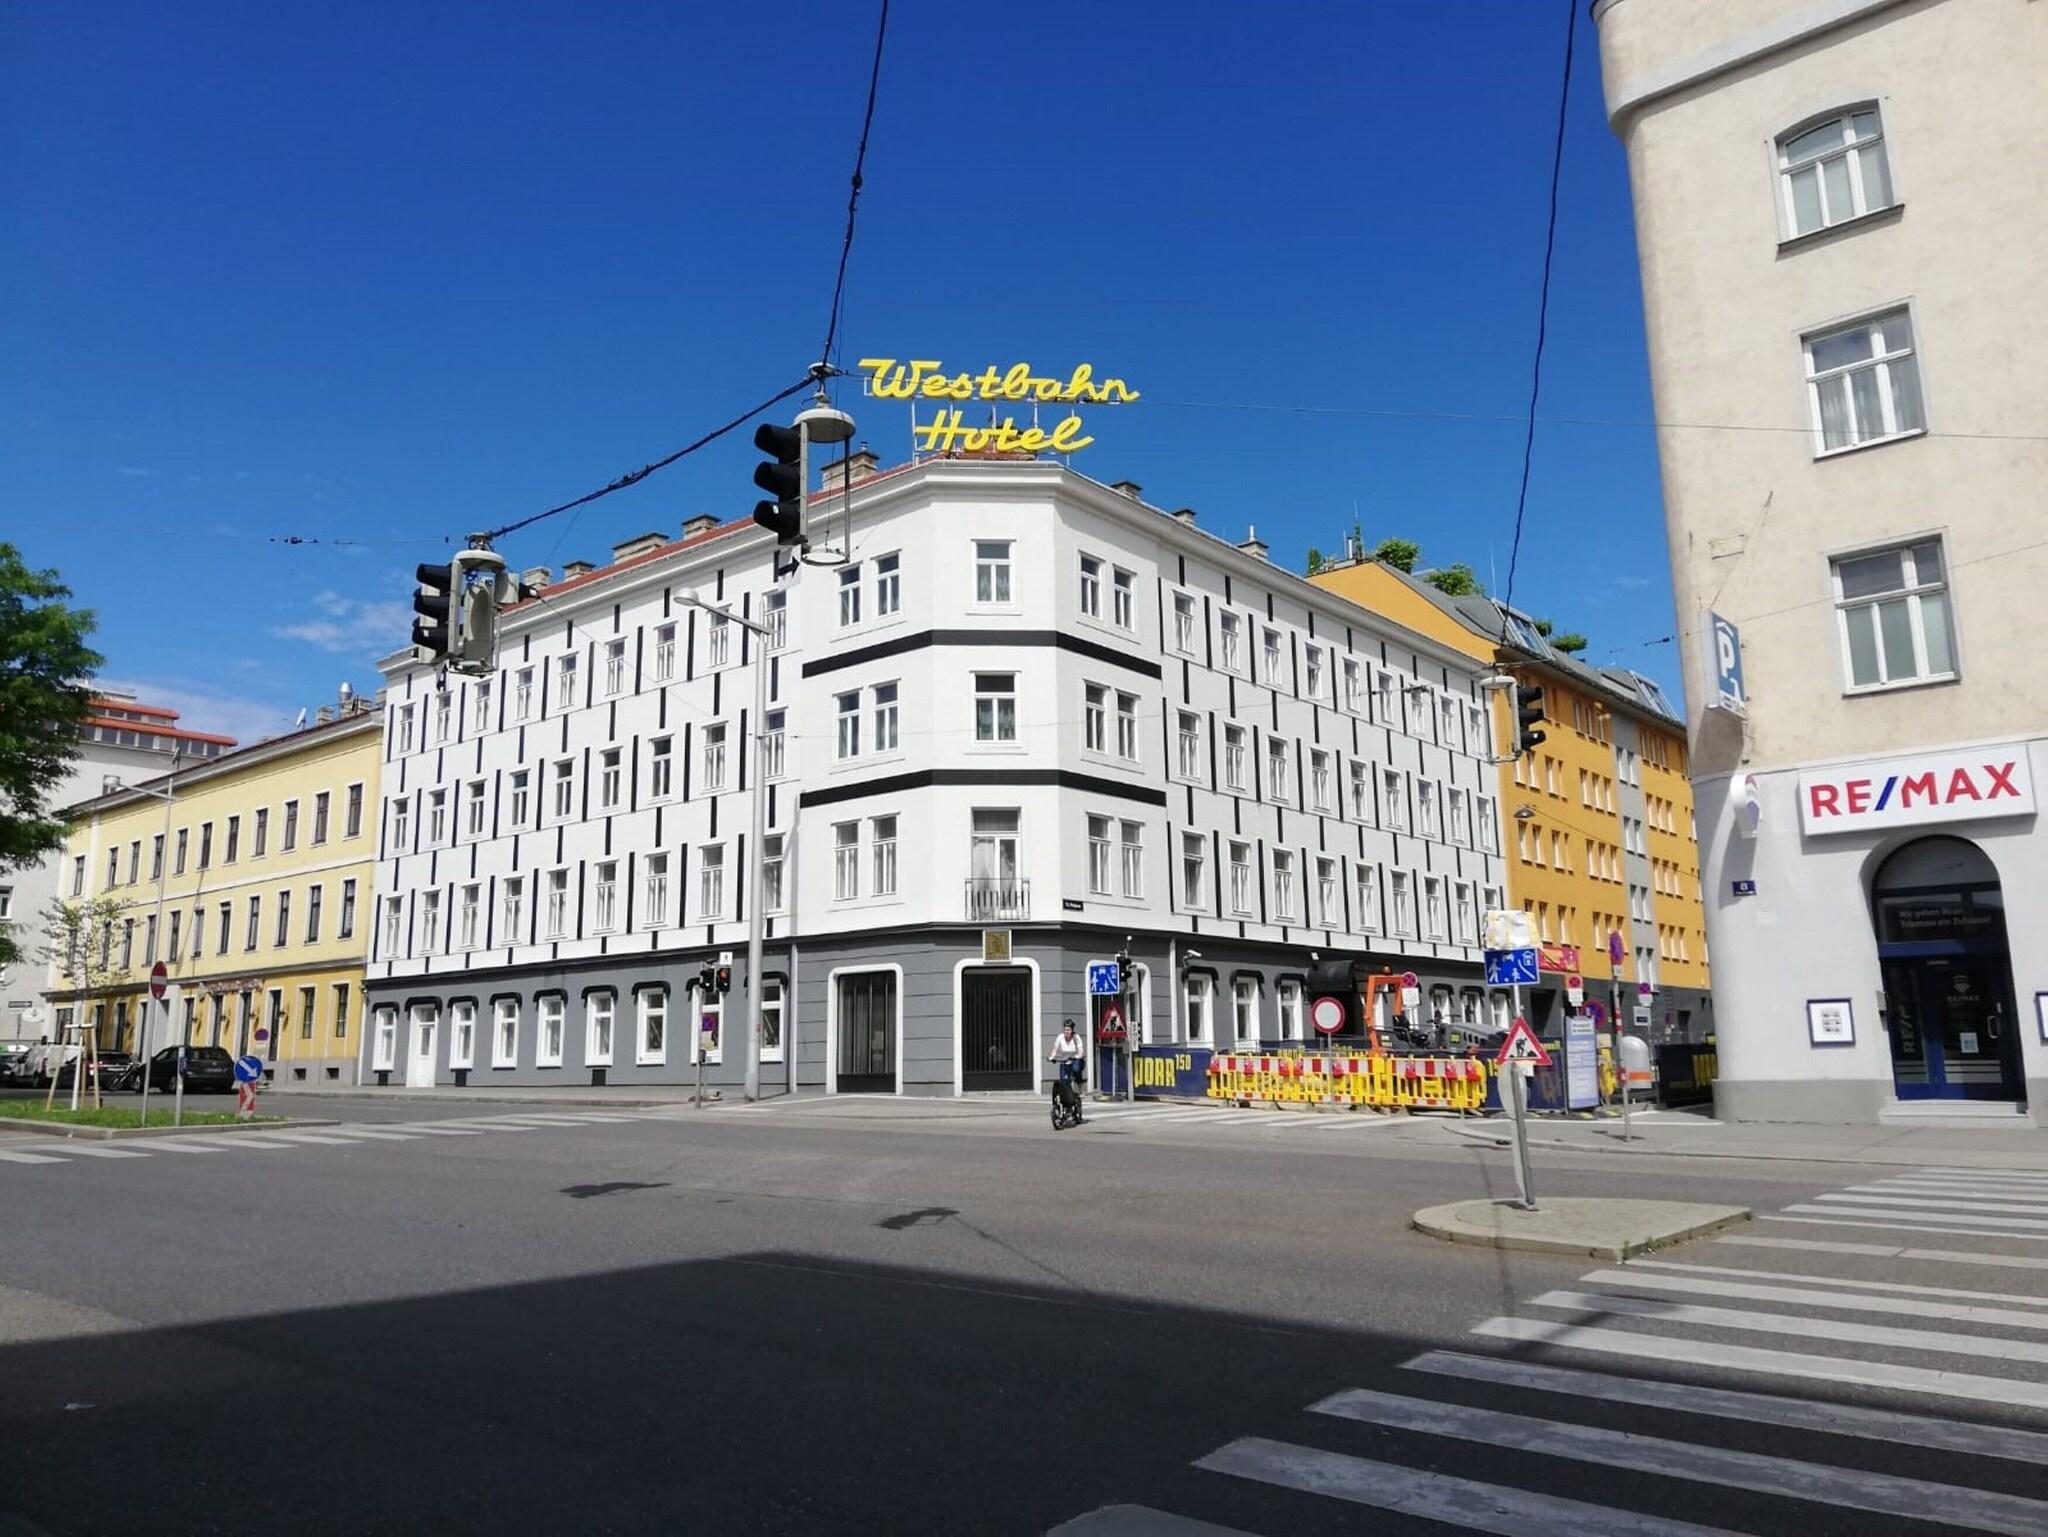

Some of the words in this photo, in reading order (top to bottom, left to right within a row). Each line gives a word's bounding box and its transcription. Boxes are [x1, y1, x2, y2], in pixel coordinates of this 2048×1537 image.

[858, 358, 1140, 402] Westbahn
[915, 409, 1095, 452] Hotel
[1718, 630, 1735, 679] P
[1810, 762, 2021, 818] RE/MAX
[1175, 1054, 1192, 1071] 150
